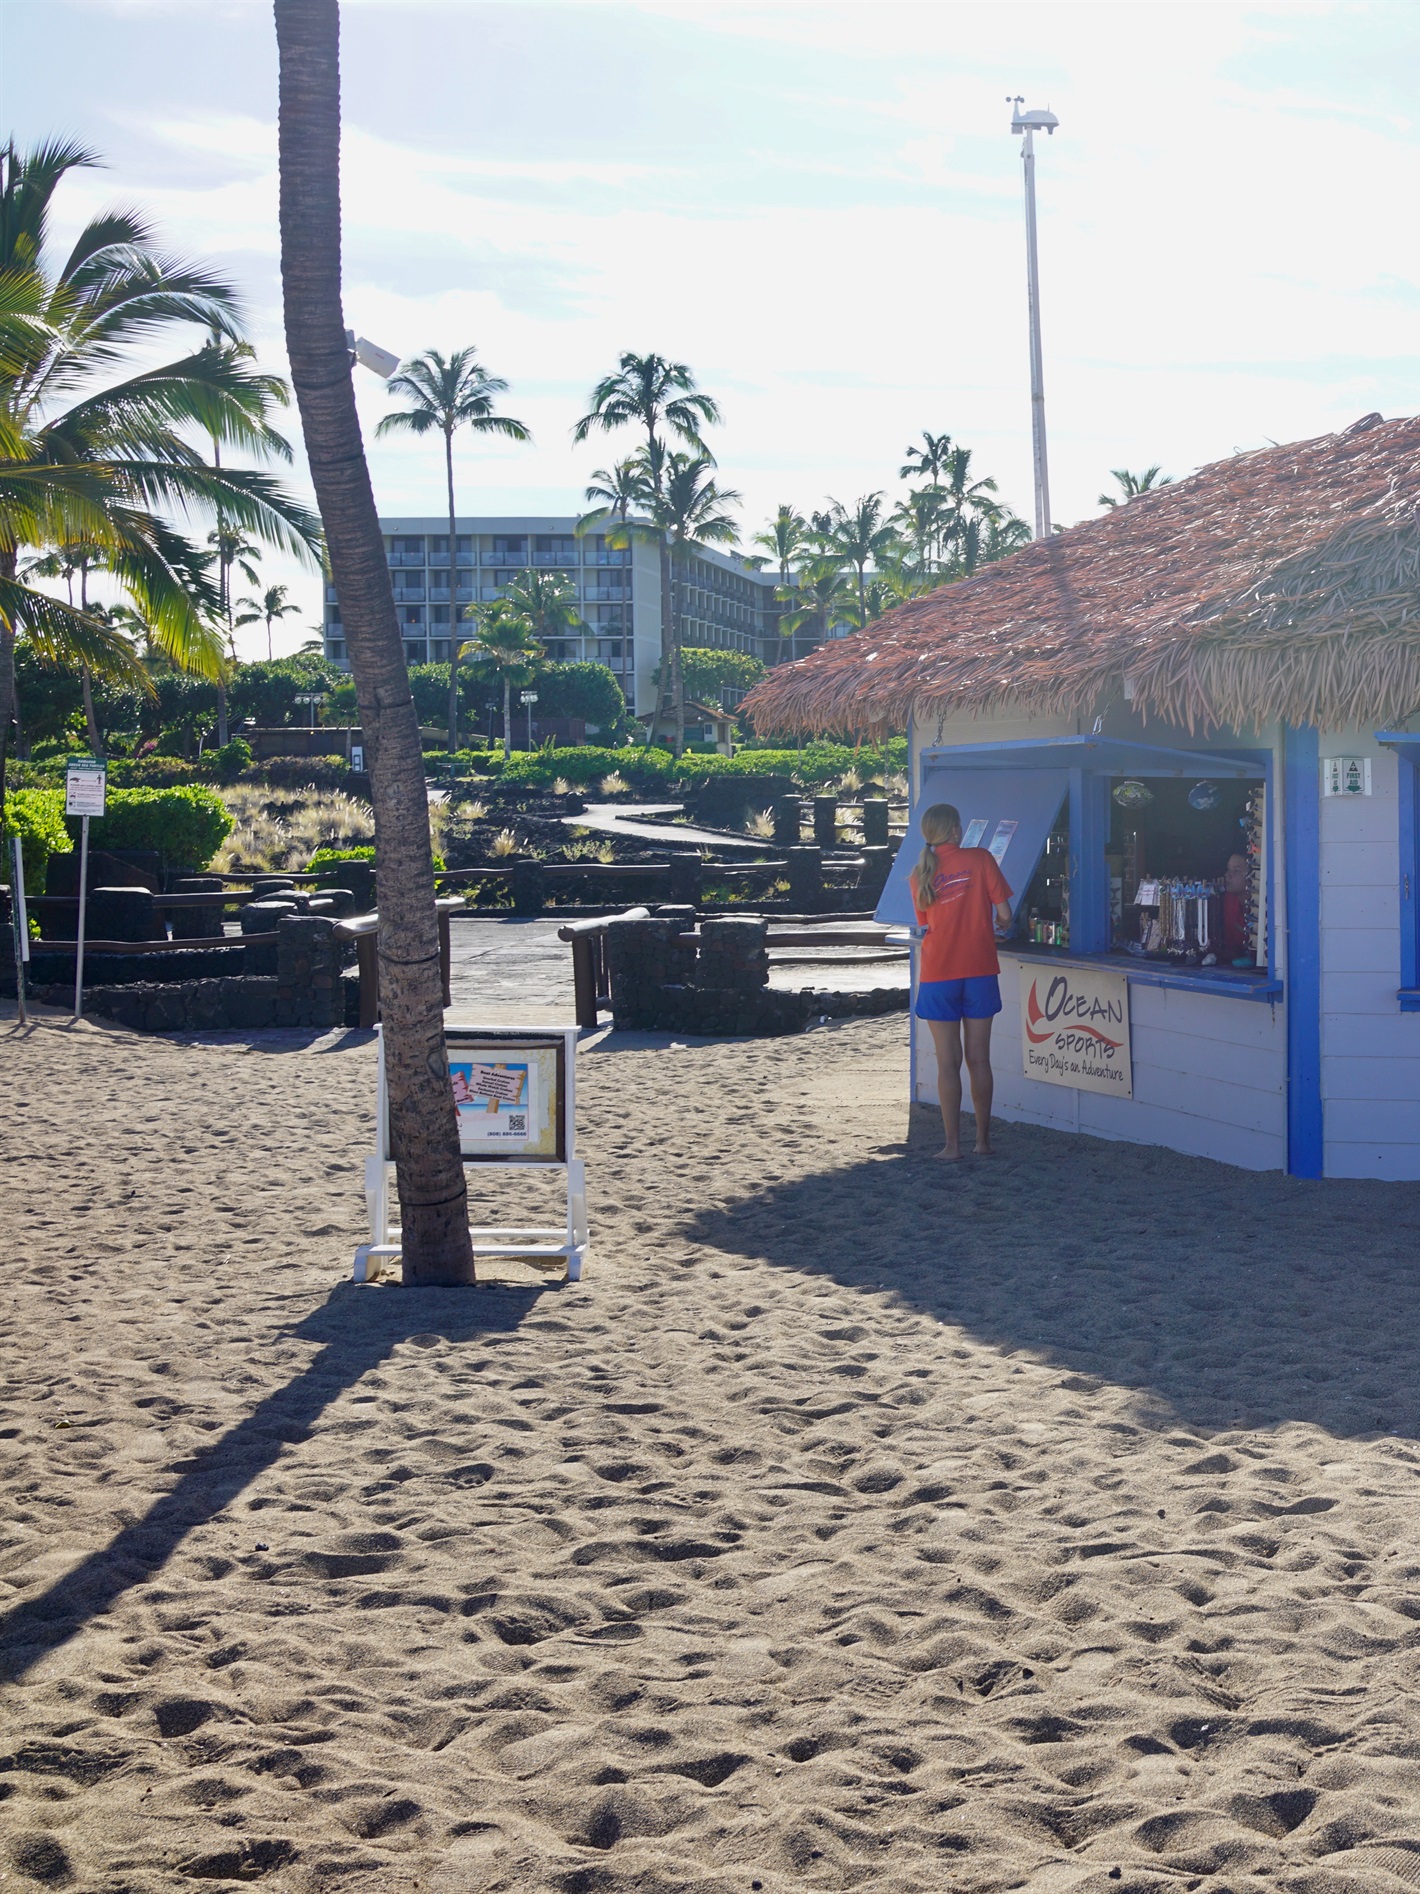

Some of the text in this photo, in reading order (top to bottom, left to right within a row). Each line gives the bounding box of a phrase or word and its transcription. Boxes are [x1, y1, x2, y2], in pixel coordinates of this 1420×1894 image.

[1045, 976, 1123, 1023] OCEAN
[1055, 1033, 1115, 1059] SPORTS
[1029, 1049, 1124, 1081] Every Day's an Adventure
